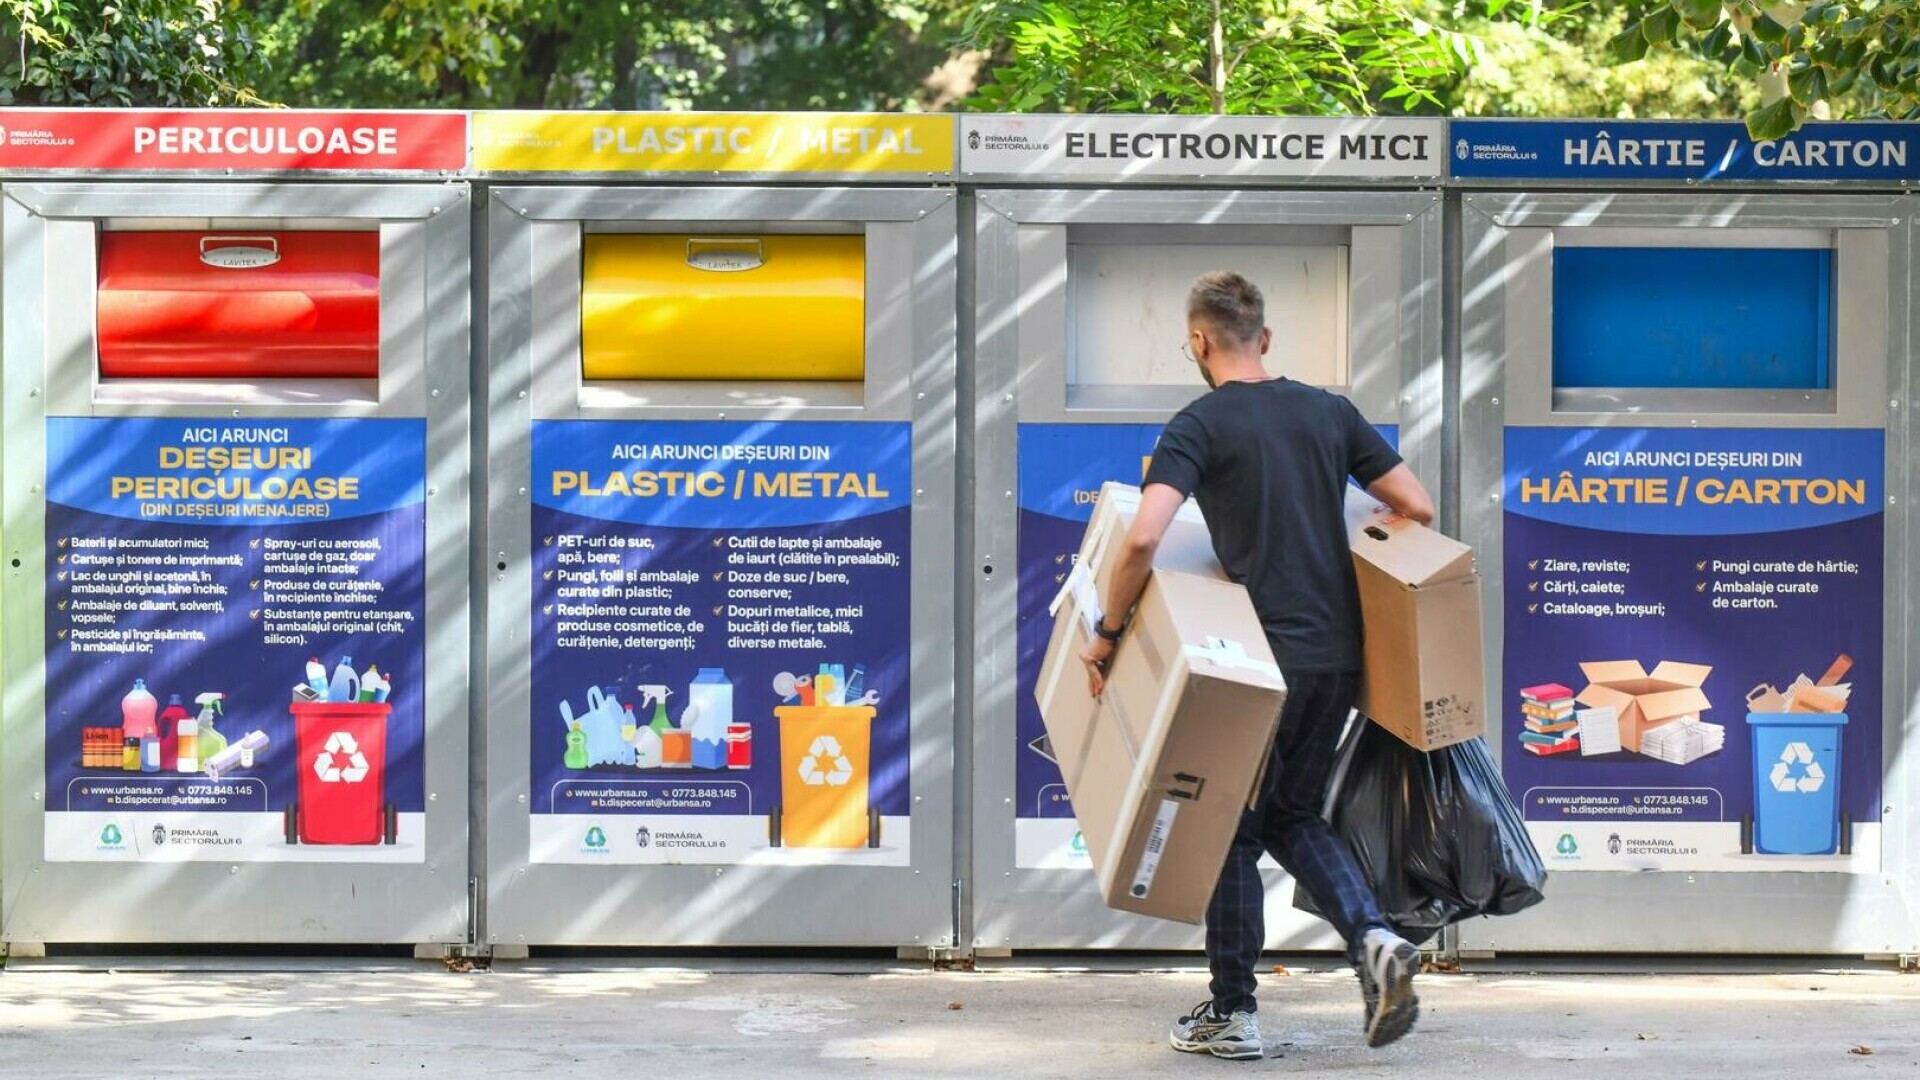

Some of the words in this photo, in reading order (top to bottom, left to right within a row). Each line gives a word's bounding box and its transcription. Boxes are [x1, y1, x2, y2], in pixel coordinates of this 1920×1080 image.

[135, 127, 398, 155] PERICULOASE
[593, 126, 752, 154] PLASTIC
[765, 126, 782, 157] /
[803, 126, 923, 155] METAL
[985, 142, 1041, 150] SECTORULUI
[1066, 133, 1324, 160] ELECTRONICE
[1340, 134, 1428, 161] MICI
[1564, 130, 1705, 165] HÂRTIE
[1720, 139, 1737, 172] /
[1754, 140, 1906, 167] CARTON
[183, 428, 217, 442] AICI
[222, 428, 288, 442] ARUNCI
[612, 445, 646, 459] AICI
[651, 445, 717, 460] ARUNCI
[722, 446, 796, 463] DEȘEURI
[801, 446, 829, 460] DIN
[160, 447, 311, 476] DEȘEURI
[1585, 452, 1619, 466] AICI
[1624, 452, 1690, 466] ARUNCI
[1695, 453, 1768, 470] DEȘEURI
[1772, 453, 1802, 467] DIN
[112, 477, 359, 499] PERICULOASE
[553, 471, 725, 497] PLASTIC
[734, 470, 745, 499] /
[754, 473, 889, 498] METAL
[1521, 471, 1668, 503] HÂRTIE
[1675, 476, 1689, 506] /
[1696, 479, 1865, 504] CARTON
[141, 503, 173, 517] (DIN
[176, 504, 240, 519] DEȘEURI
[243, 503, 329, 518] MENAJERE)
[71, 538, 106, 547] Baterii
[119, 538, 182, 547] acumulatori
[264, 539, 317, 550] Spray-uri
[558, 535, 606, 547] PET-uri
[609, 536, 625, 547] de
[628, 537, 654, 549] suc,
[729, 536, 758, 548] Cutii
[760, 536, 776, 548] de
[778, 537, 810, 550] lapte
[825, 537, 882, 550] ambalaje
[308, 551, 323, 561] de
[326, 553, 347, 563] gaz,
[350, 551, 375, 561] doar
[588, 552, 620, 564] bere;
[729, 553, 744, 564] de
[747, 553, 776, 564] iaurt
[838, 553, 899, 566] prealabil);
[264, 564, 315, 574] ambalaje
[1544, 559, 1580, 573] Ziare,
[1583, 560, 1630, 573] reviste;
[1713, 561, 1750, 575] Pungi
[1753, 563, 1794, 573] curate
[1798, 561, 1814, 573] de
[1817, 561, 1858, 574] hârtie;
[558, 570, 597, 583] Pungi,
[600, 570, 623, 582] folii
[640, 571, 699, 584] ambalaje
[729, 571, 761, 582] Doze
[764, 571, 781, 582] de
[784, 573, 806, 582] suc
[809, 571, 814, 584] /
[817, 572, 849, 584] bere,
[264, 580, 310, 589] Produse
[313, 580, 326, 589] de
[1581, 582, 1625, 595] caiete;
[1713, 581, 1773, 595] Ambalaje
[1777, 583, 1818, 593] curate
[276, 593, 332, 604] recipiente
[558, 587, 600, 597] curate
[602, 586, 622, 597] din
[626, 586, 672, 599] plastic;
[728, 589, 791, 600] conserve;
[71, 601, 122, 611] Ambalaje
[124, 601, 137, 610] de
[1713, 598, 1729, 608] de
[1732, 598, 1777, 609] carton.
[324, 611, 360, 621] pentru
[558, 604, 627, 616] Recipiente
[630, 606, 671, 616] curate
[674, 605, 690, 616] de
[729, 605, 772, 619] Dopuri
[775, 606, 833, 618] metalice,
[836, 605, 863, 617] mici
[1544, 603, 1613, 617] Cataloage,
[1616, 603, 1665, 617] broșuri;
[71, 614, 115, 623] vopsele;
[277, 622, 330, 633] ambalajul
[332, 622, 373, 632] original
[558, 621, 611, 633] produse
[614, 621, 685, 633] cosmetice,
[687, 621, 704, 632] de
[772, 621, 788, 632] de
[791, 621, 815, 634] fier,
[264, 635, 307, 644] silicon).
[728, 637, 776, 648] diverse
[778, 637, 826, 648] metale.
[188, 787, 252, 795] 0773.848.145
[575, 789, 648, 797] www.urbansa.ro
[672, 789, 736, 797] 0773.848.145
[115, 796, 227, 805] b.dispecerat@urbansa.ro
[600, 799, 711, 808] b.dispecerat@urbansa.ro
[1547, 796, 1619, 804] www.urbansa.ro
[1644, 796, 1708, 805] 0773.848.145
[1571, 806, 1682, 814] b.dispecerat@urbansa.ro
